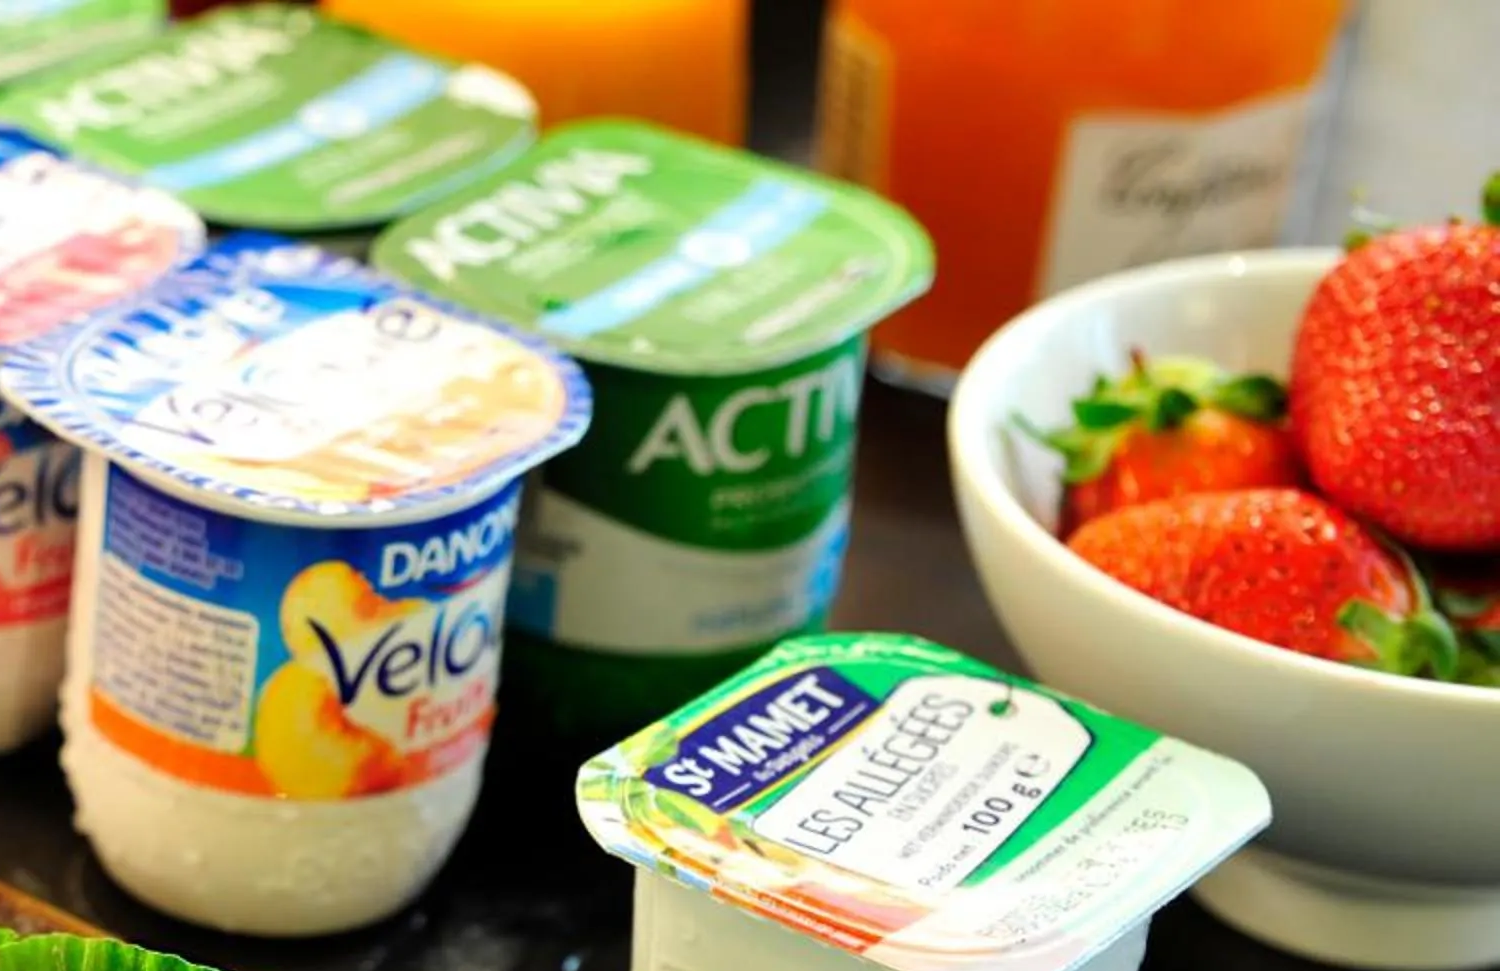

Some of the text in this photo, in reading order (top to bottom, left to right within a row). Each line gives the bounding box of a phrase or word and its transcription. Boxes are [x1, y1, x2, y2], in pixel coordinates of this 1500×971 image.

[663, 757, 715, 797] St
[699, 674, 845, 777] MAMET
[783, 808, 864, 855] LES
[832, 692, 975, 818] ALLÉGÉES
[961, 796, 1014, 835] 100
[1011, 783, 1043, 800] g
